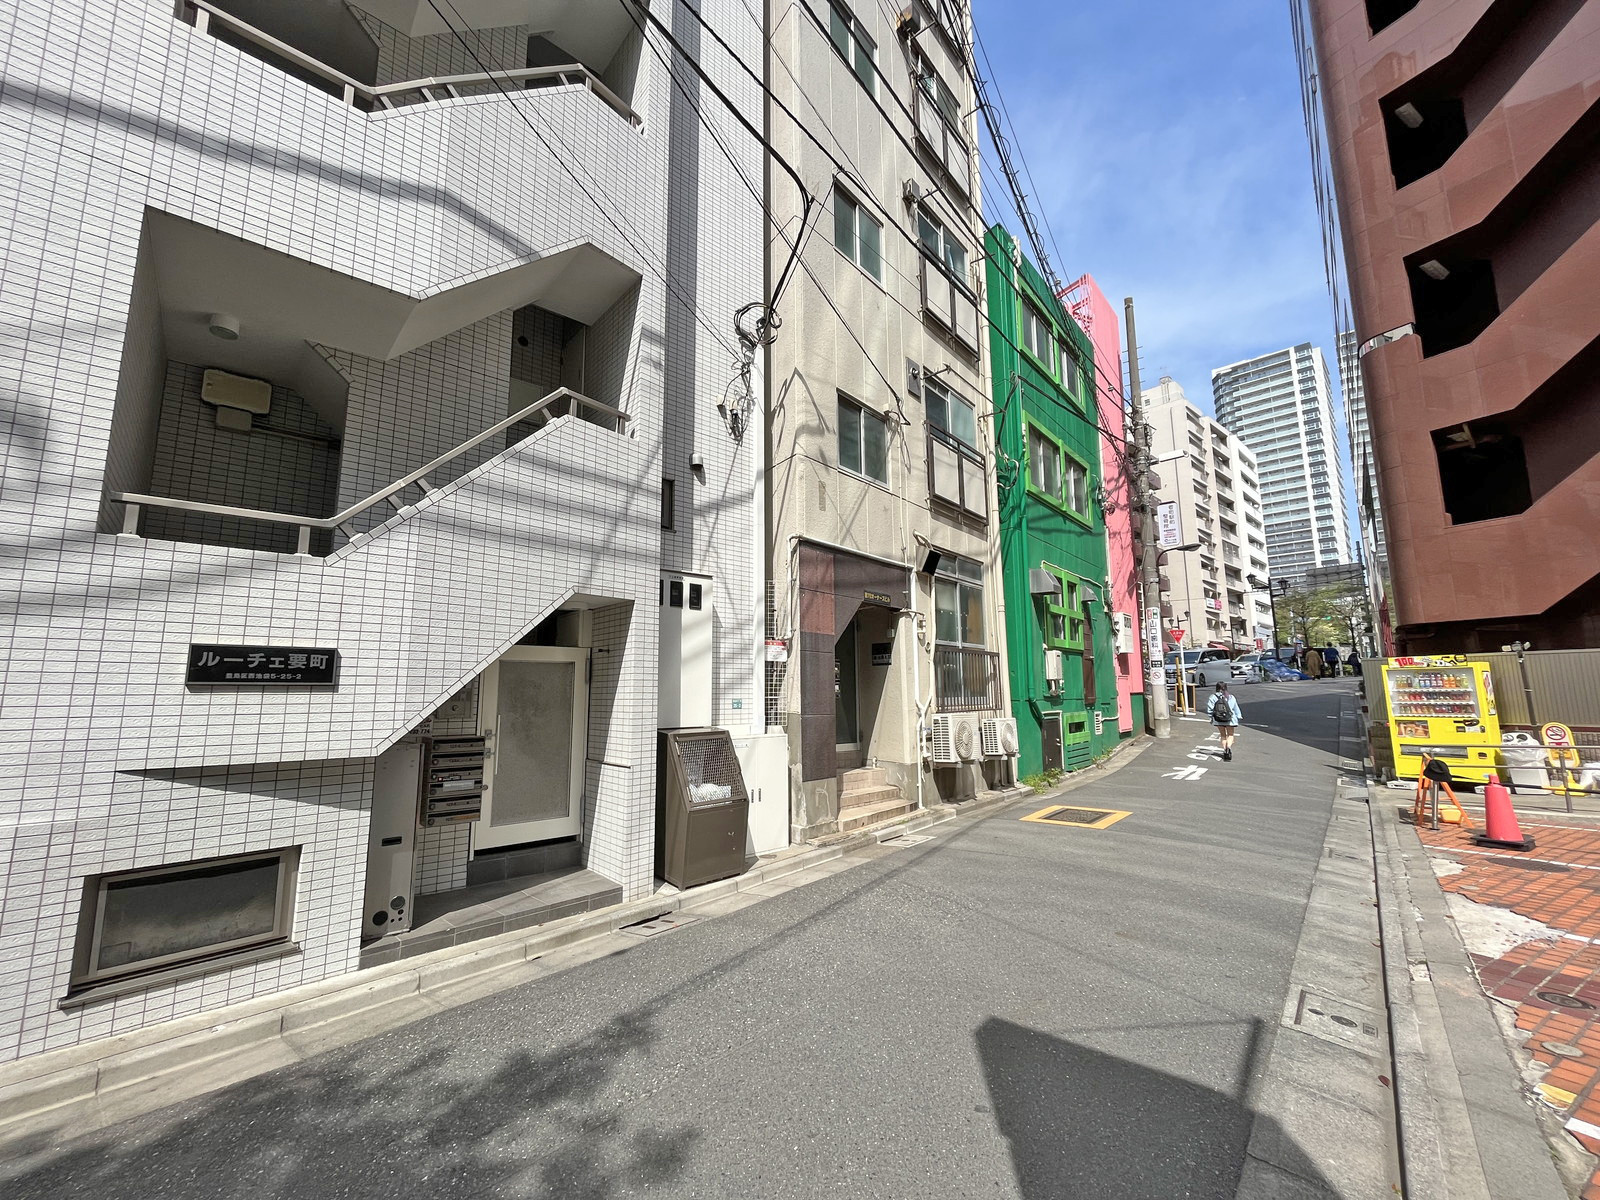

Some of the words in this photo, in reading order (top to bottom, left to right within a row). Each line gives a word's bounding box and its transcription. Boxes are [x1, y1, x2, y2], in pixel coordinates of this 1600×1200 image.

[1150, 620, 1159, 649] 山口歯科
[197, 652, 329, 669] ルーチェ要町
